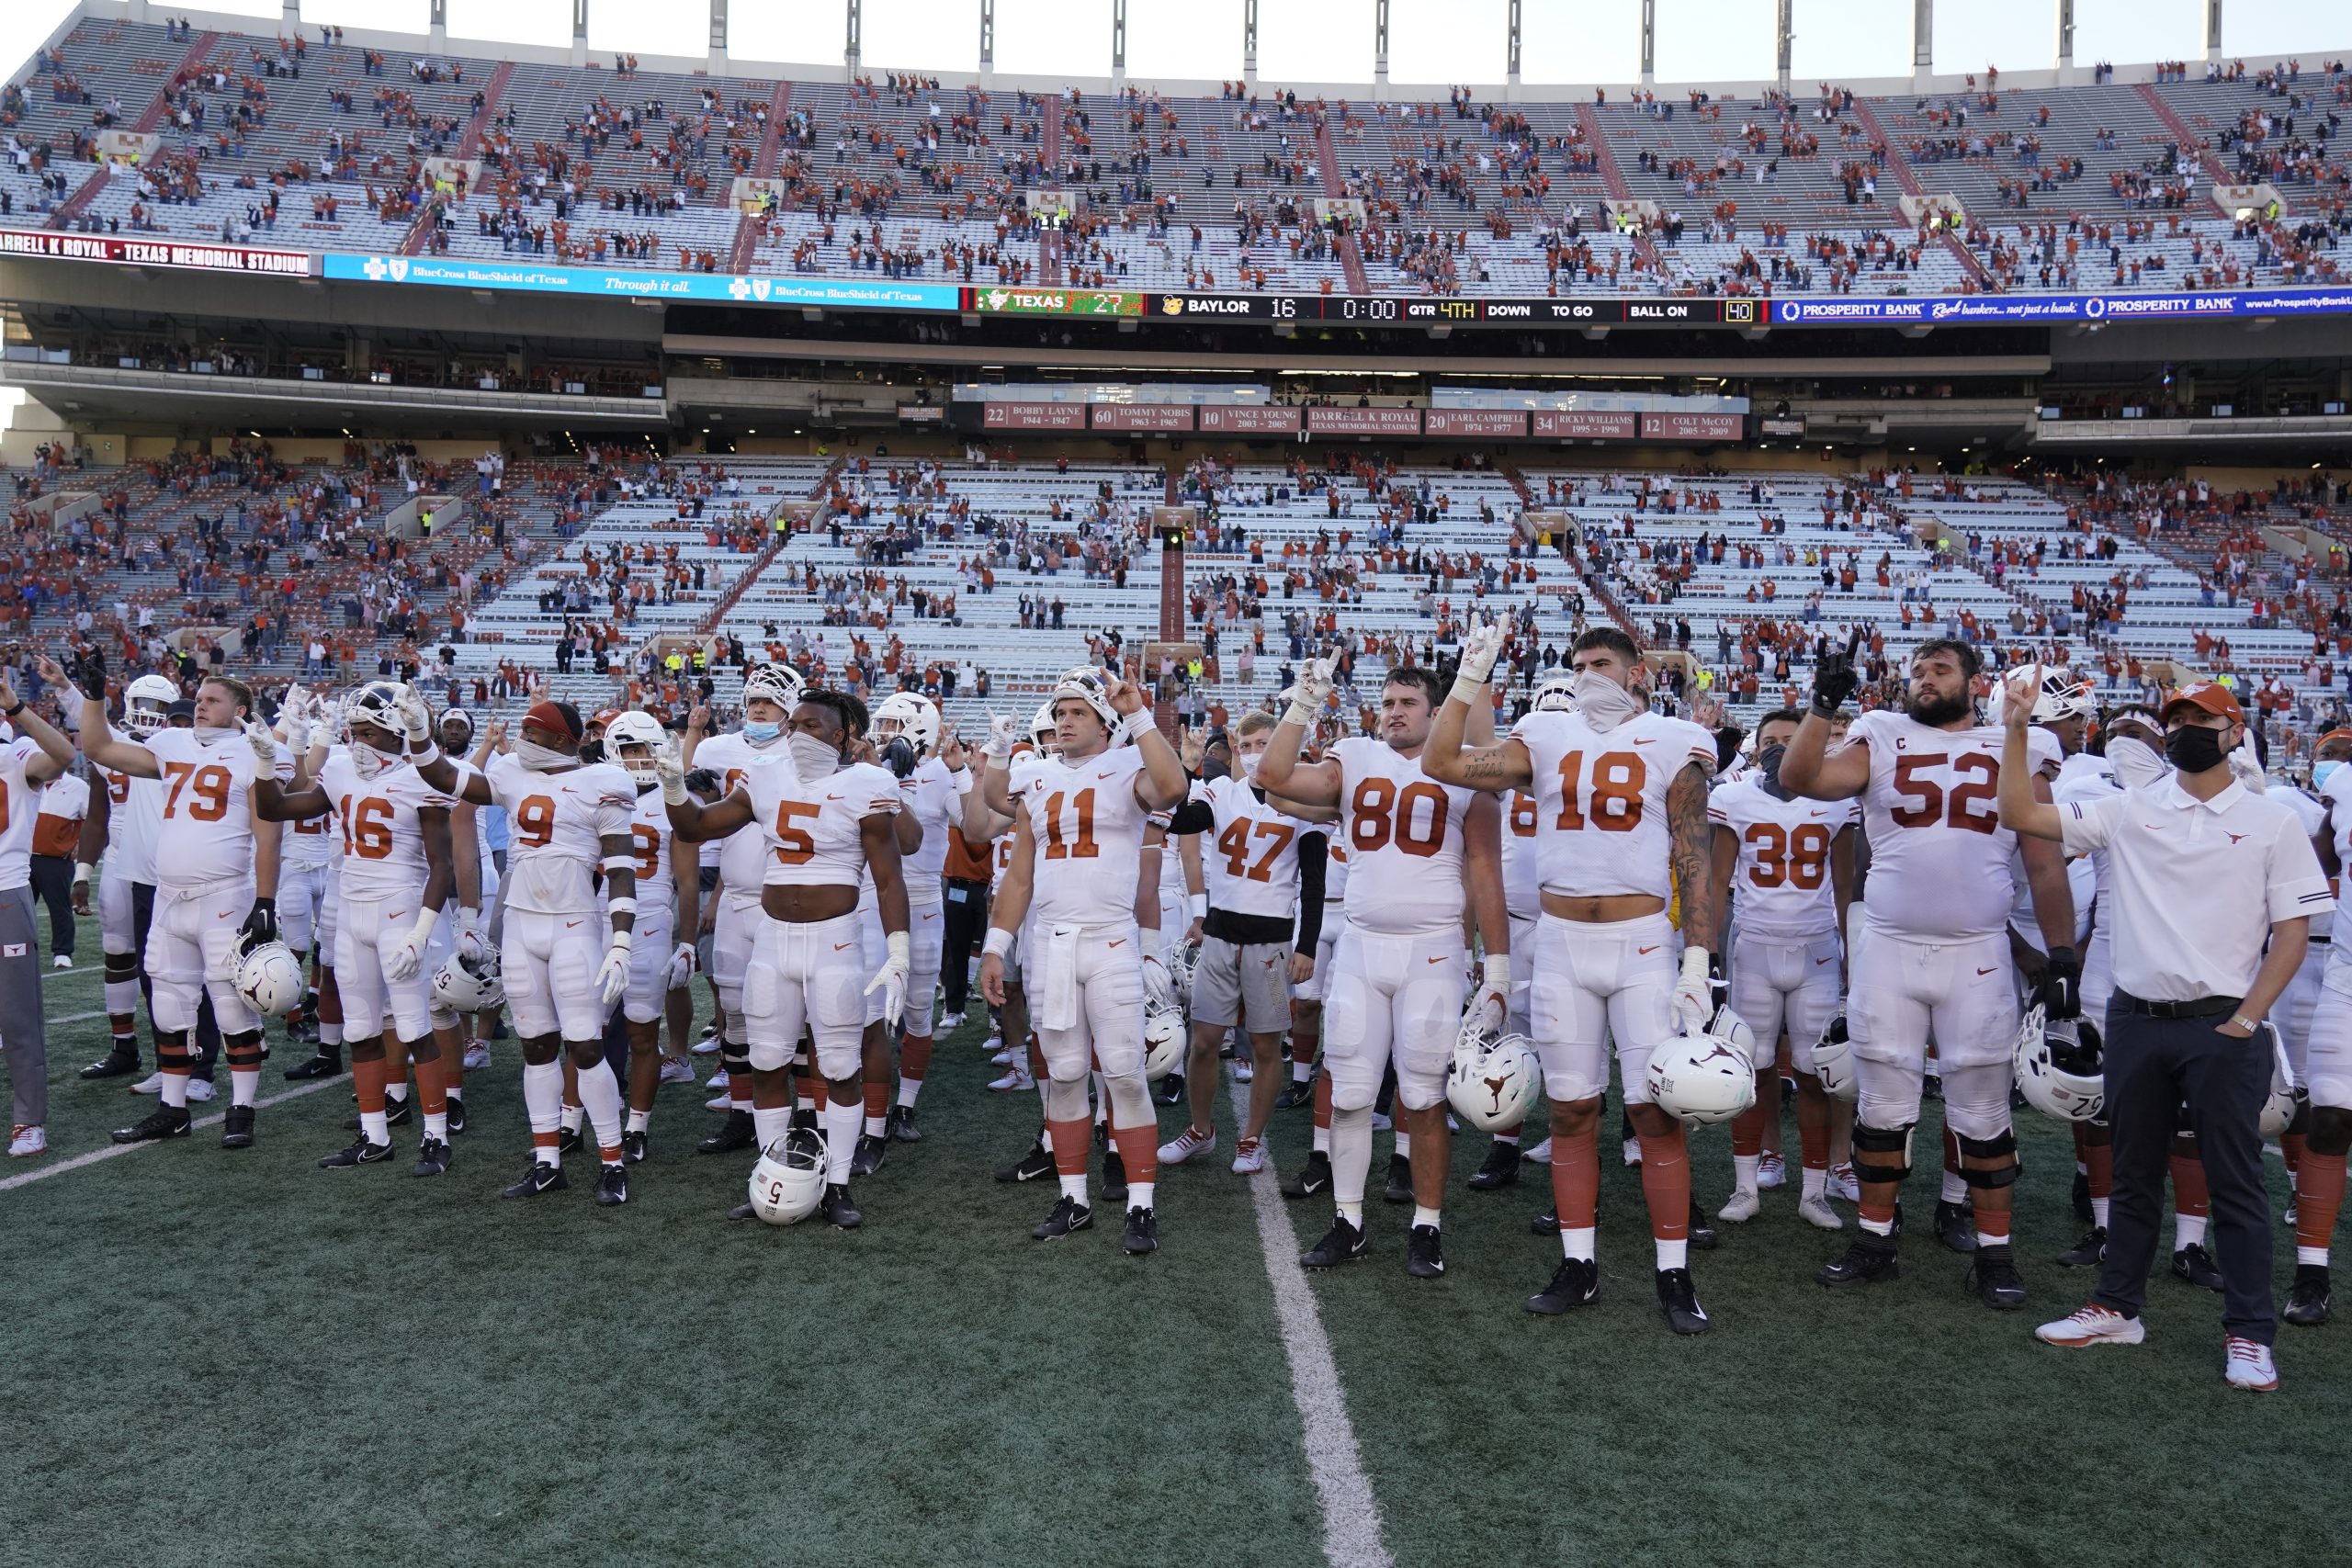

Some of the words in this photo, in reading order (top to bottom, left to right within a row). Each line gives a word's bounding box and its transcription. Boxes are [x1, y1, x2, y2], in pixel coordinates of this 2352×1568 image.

[49, 237, 60, 254] K
[63, 239, 107, 258] ROYAL
[124, 243, 168, 263] TEXAS
[172, 246, 244, 268] MEMORIAL
[247, 253, 309, 274] STADIUM
[413, 266, 466, 279] BlueCross
[468, 270, 523, 283] BlueShield
[525, 273, 536, 284] of
[535, 274, 568, 285] Texas
[605, 277, 658, 293] Through
[661, 279, 670, 291] it
[672, 280, 691, 292] all.
[775, 286, 825, 298] BlueCross
[827, 288, 879, 299] BlueShield
[880, 290, 892, 300] of
[892, 290, 922, 301] Texas
[1013, 295, 1064, 308] TEXAS
[1093, 294, 1123, 313] 27
[1188, 299, 1250, 313] BAYLOR
[1272, 299, 1295, 318] 16
[1931, 299, 1962, 318] Real
[2007, 303, 2022, 314] not
[2021, 303, 2041, 317] just
[2041, 305, 2050, 313] a
[2107, 299, 2189, 312] PROSPERITY
[1343, 299, 1396, 320] 0:00
[1408, 305, 1435, 316] QTR
[1441, 302, 1475, 319] 4TH
[1487, 305, 1531, 317] DOWN
[1551, 305, 1570, 317] TO
[1572, 306, 1593, 317] GO
[1630, 306, 1664, 317] BALL
[1667, 306, 1688, 317] ON
[1729, 303, 1749, 319] 40
[1803, 304, 1881, 316] PROSPERITY
[987, 408, 1004, 422] 22
[1012, 406, 1045, 415] BOBBY
[1048, 407, 1080, 415] LAYNE
[1094, 410, 1112, 423] 60
[1118, 408, 1157, 417] TOMMY
[1160, 409, 1191, 417] NOBIS
[1227, 410, 1259, 419] VINCE
[1262, 411, 1297, 419] YOUNG
[1311, 411, 1365, 422] DARRELL
[1368, 412, 1377, 422] K
[1381, 412, 1418, 423] ROYAL
[1023, 416, 1041, 424] 1944
[1052, 416, 1071, 425] 1947
[1131, 418, 1149, 426] 1963
[1159, 418, 1179, 427] 1965
[1204, 412, 1219, 425] 10
[1237, 420, 1257, 428] 2003
[1267, 420, 1287, 429] 2005
[1429, 415, 1445, 429] 20
[1451, 413, 1475, 422] EARL
[1476, 413, 1525, 423] CAMPBELL
[1536, 416, 1553, 431] 34
[1559, 415, 1585, 423] RICKY
[1587, 415, 1633, 424] WILLIAMS
[1672, 417, 1698, 425] COLT
[1702, 417, 1735, 426] McCOY
[1311, 422, 1336, 430] TEXAS
[1464, 423, 1482, 432] 1974
[1493, 423, 1512, 433] 1977
[1572, 425, 1590, 434] 1995
[1601, 425, 1620, 434] 1998
[1645, 419, 1660, 433] 12
[1679, 426, 1698, 434] 2005
[1709, 427, 1728, 435] 2009
[1895, 738, 1906, 750] C
[164, 761, 232, 822] 79
[1035, 779, 1042, 791] C
[1555, 750, 1646, 832] 18
[1890, 751, 1999, 835] 52
[517, 795, 557, 849] 9
[1044, 787, 1099, 860] 11
[1351, 777, 1449, 858] 80
[340, 795, 395, 860] 16
[775, 800, 821, 865] 5
[1218, 816, 1295, 883] 47
[1746, 822, 1831, 890] 38
[1648, 1064, 1663, 1097] 18
[2070, 1095, 2103, 1117] 52
[768, 1181, 782, 1205] 5
